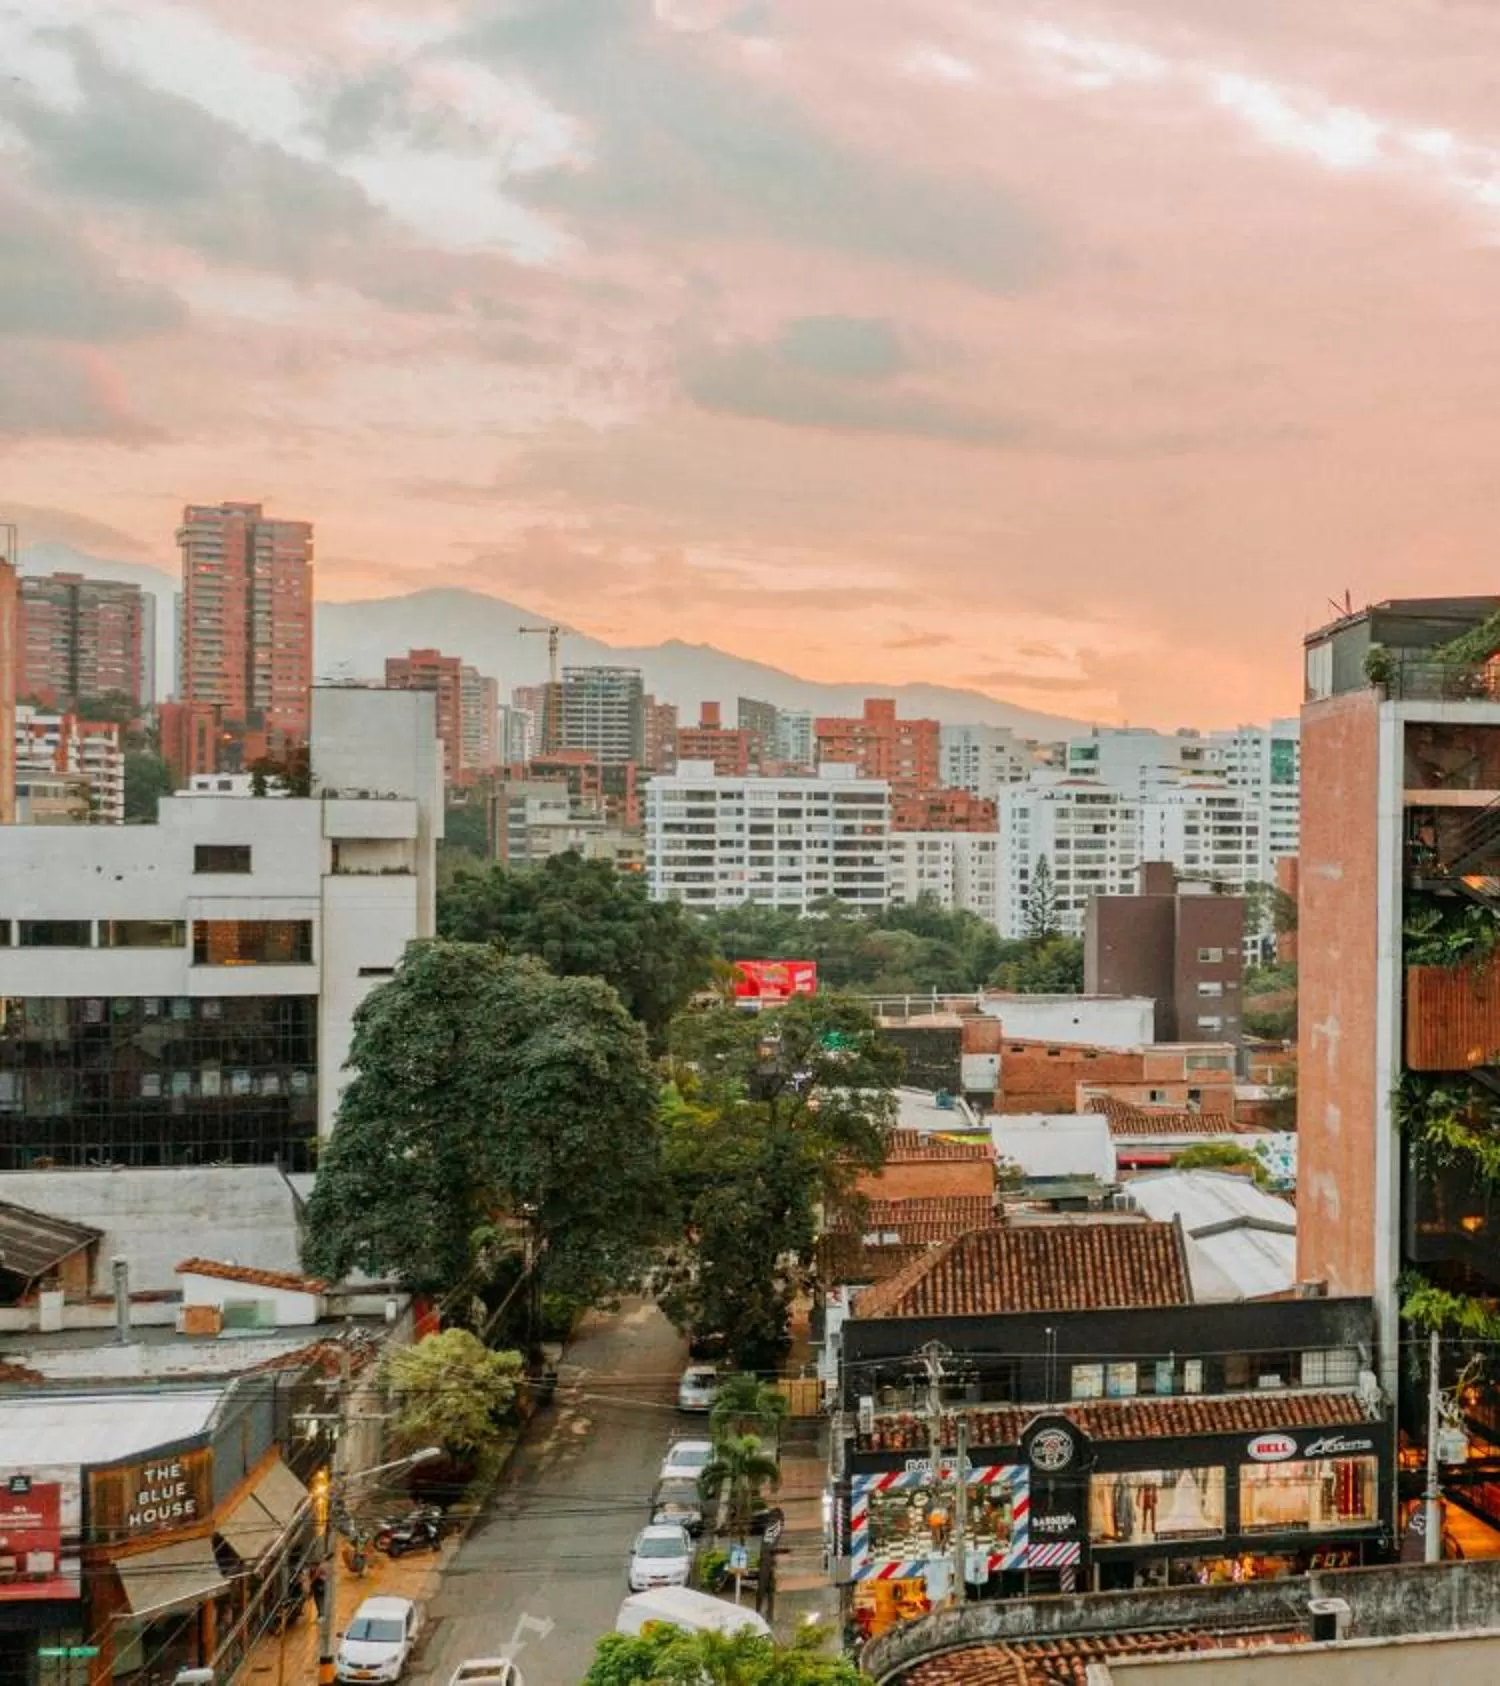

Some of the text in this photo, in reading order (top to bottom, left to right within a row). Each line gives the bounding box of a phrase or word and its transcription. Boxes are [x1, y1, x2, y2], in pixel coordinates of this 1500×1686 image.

[144, 1464, 181, 1484] THE
[139, 1482, 187, 1505] BLUE
[129, 1500, 196, 1527] HOUSE
